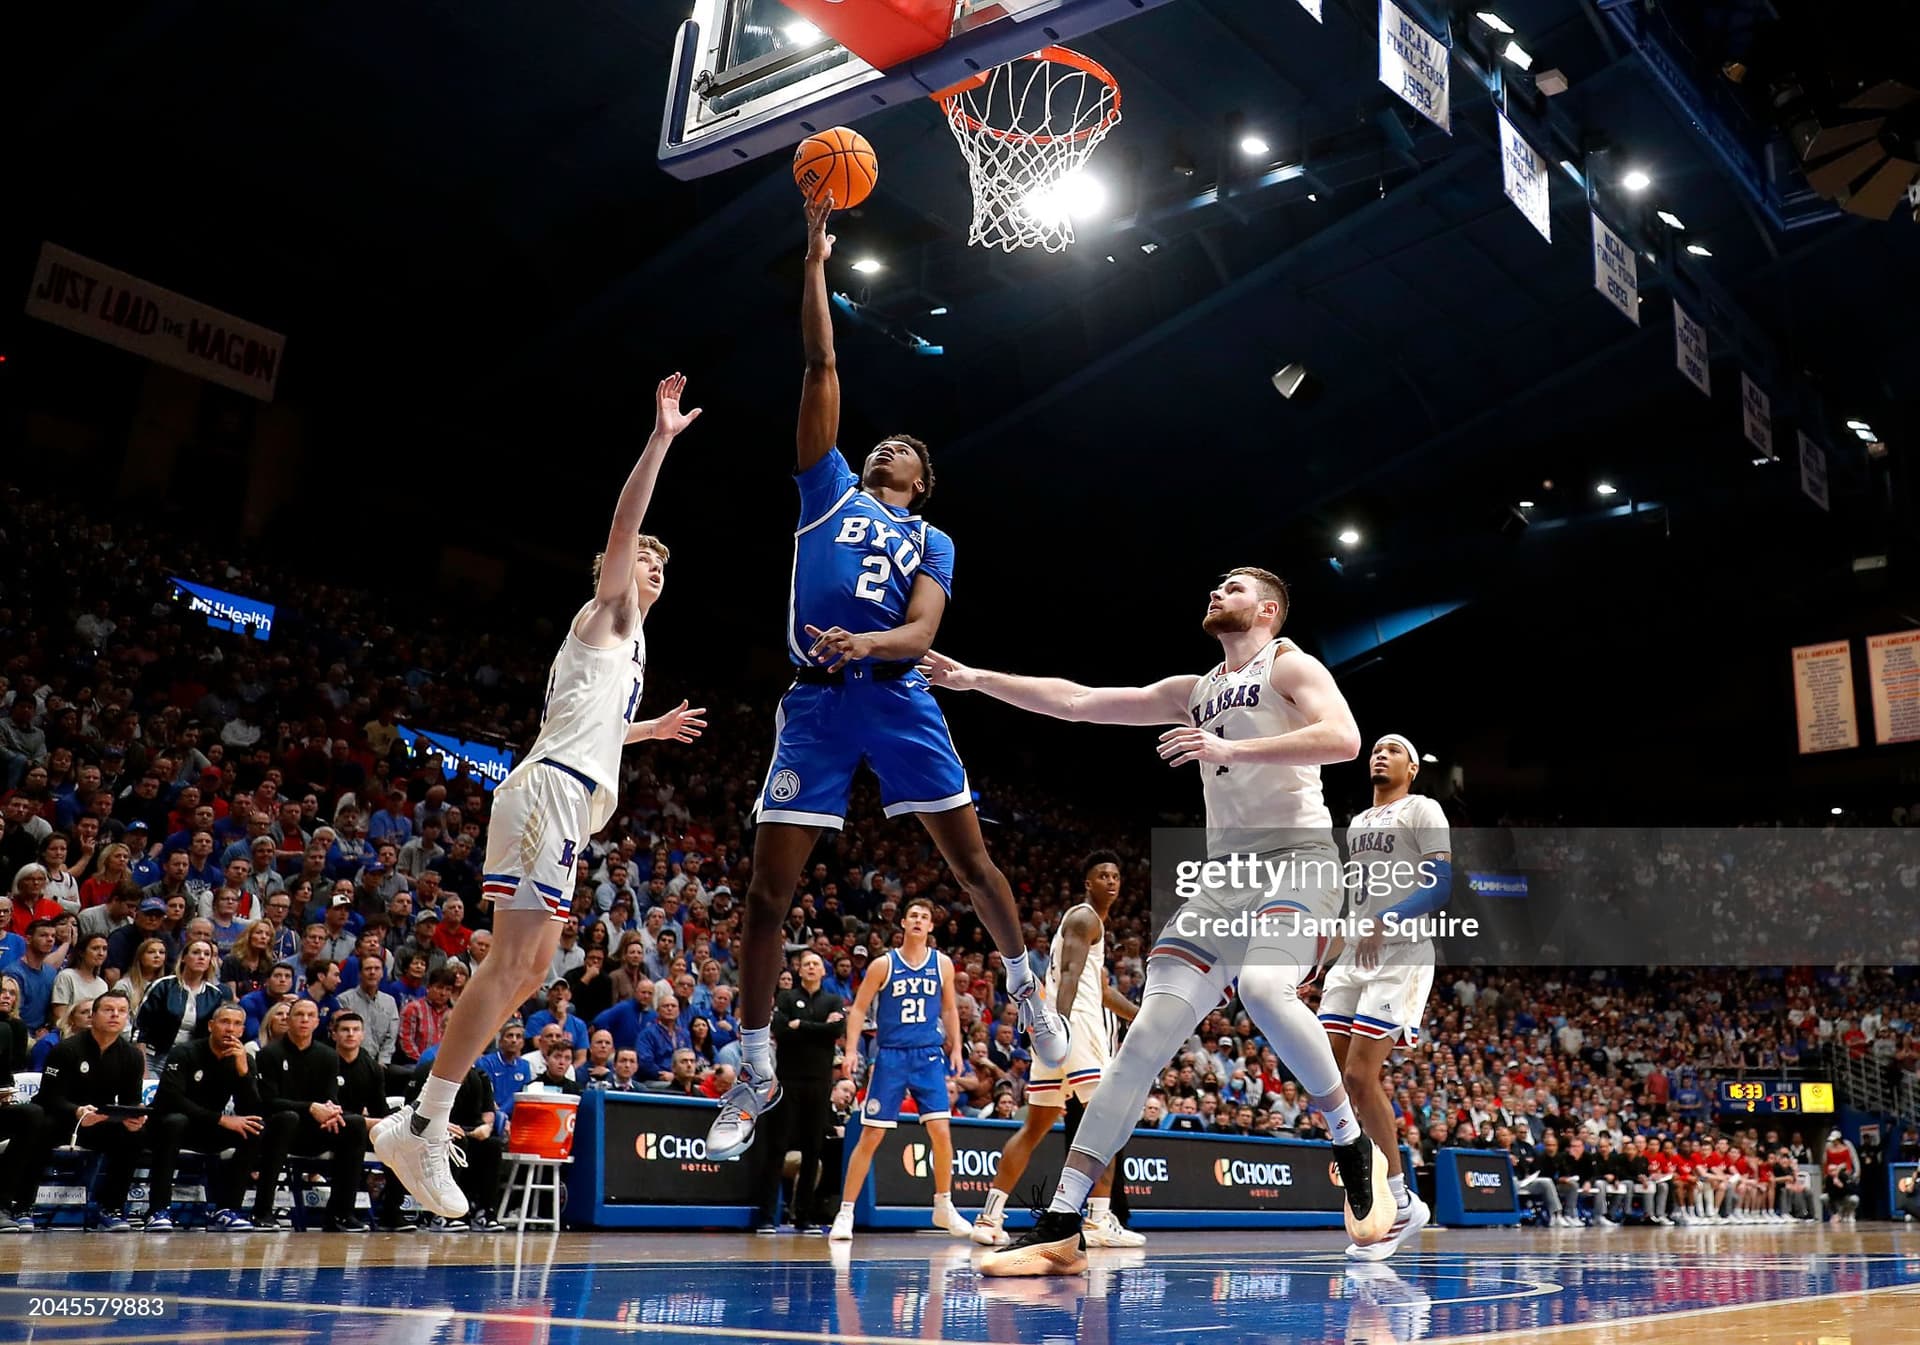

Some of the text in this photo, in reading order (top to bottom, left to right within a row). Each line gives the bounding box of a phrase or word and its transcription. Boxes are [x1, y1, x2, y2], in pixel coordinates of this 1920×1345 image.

[37, 262, 277, 382] JUST LOAD THE WAGON
[835, 517, 922, 577] BYU
[855, 555, 892, 603] 2
[1351, 831, 1395, 854] ANSAS
[892, 978, 938, 997] BYU
[901, 998, 927, 1024] 21
[1123, 1157, 1169, 1182] OICE
[1231, 1160, 1293, 1185] CHOICE
[1473, 1172, 1502, 1187] CHOICE
[1123, 1186, 1153, 1195] OTELS
[1250, 1188, 1280, 1198] HOTELS
